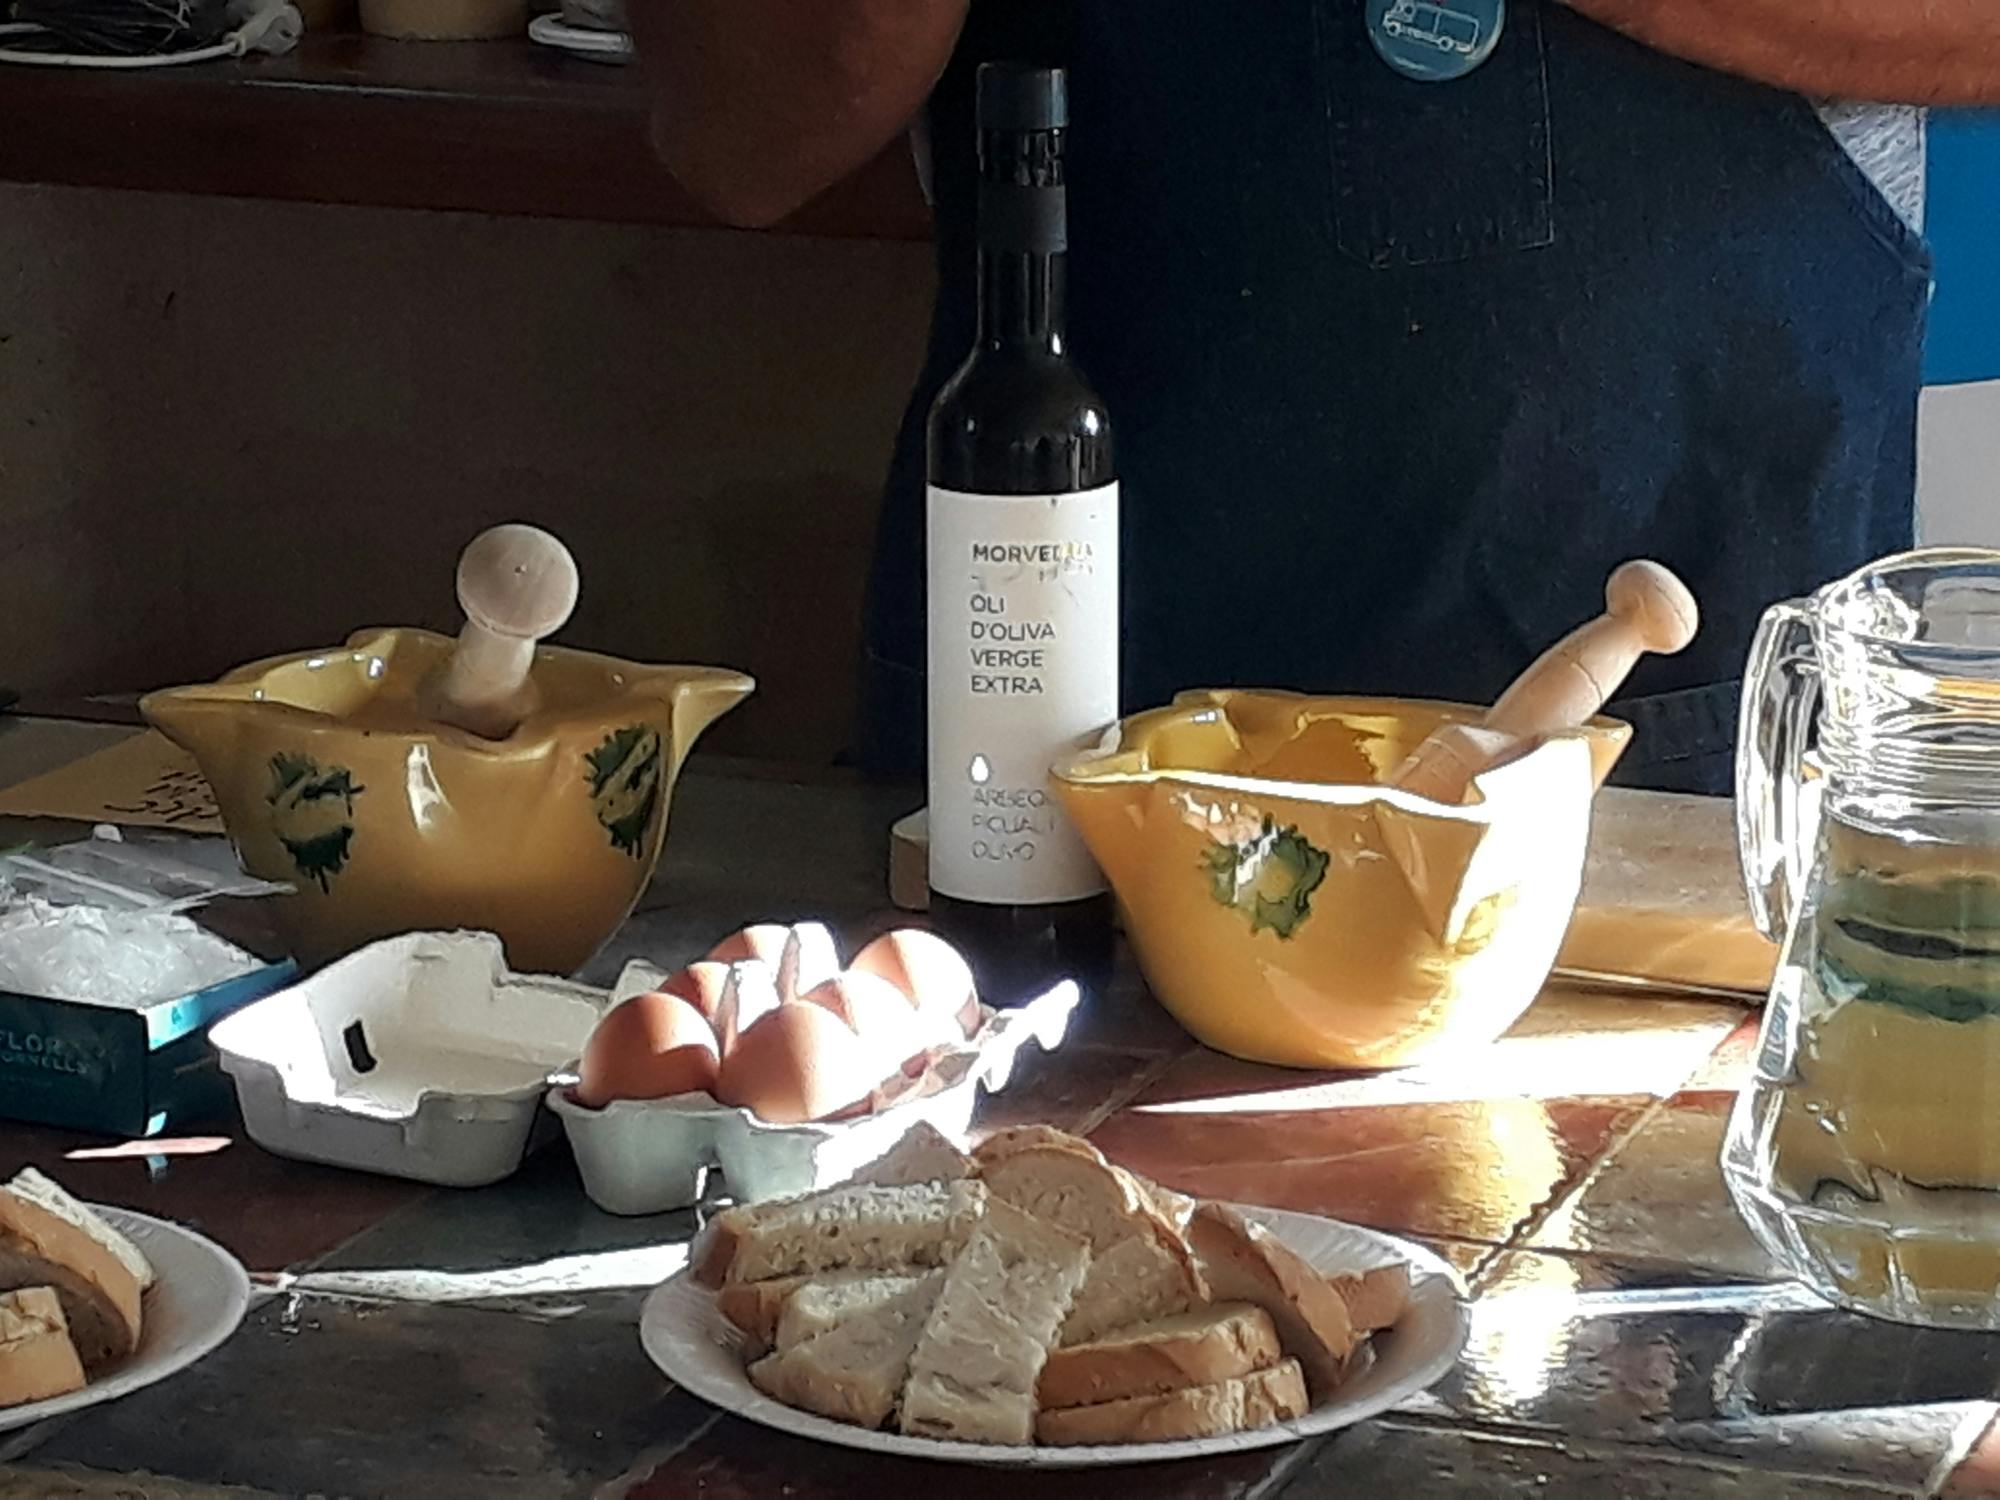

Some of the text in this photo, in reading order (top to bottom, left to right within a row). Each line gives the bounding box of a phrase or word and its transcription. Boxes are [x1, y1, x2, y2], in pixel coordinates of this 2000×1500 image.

[970, 594, 1005, 614] OLI
[970, 620, 1056, 641] D'OLIVA
[970, 647, 1044, 668] VERGE
[970, 675, 1043, 694] EXTRA
